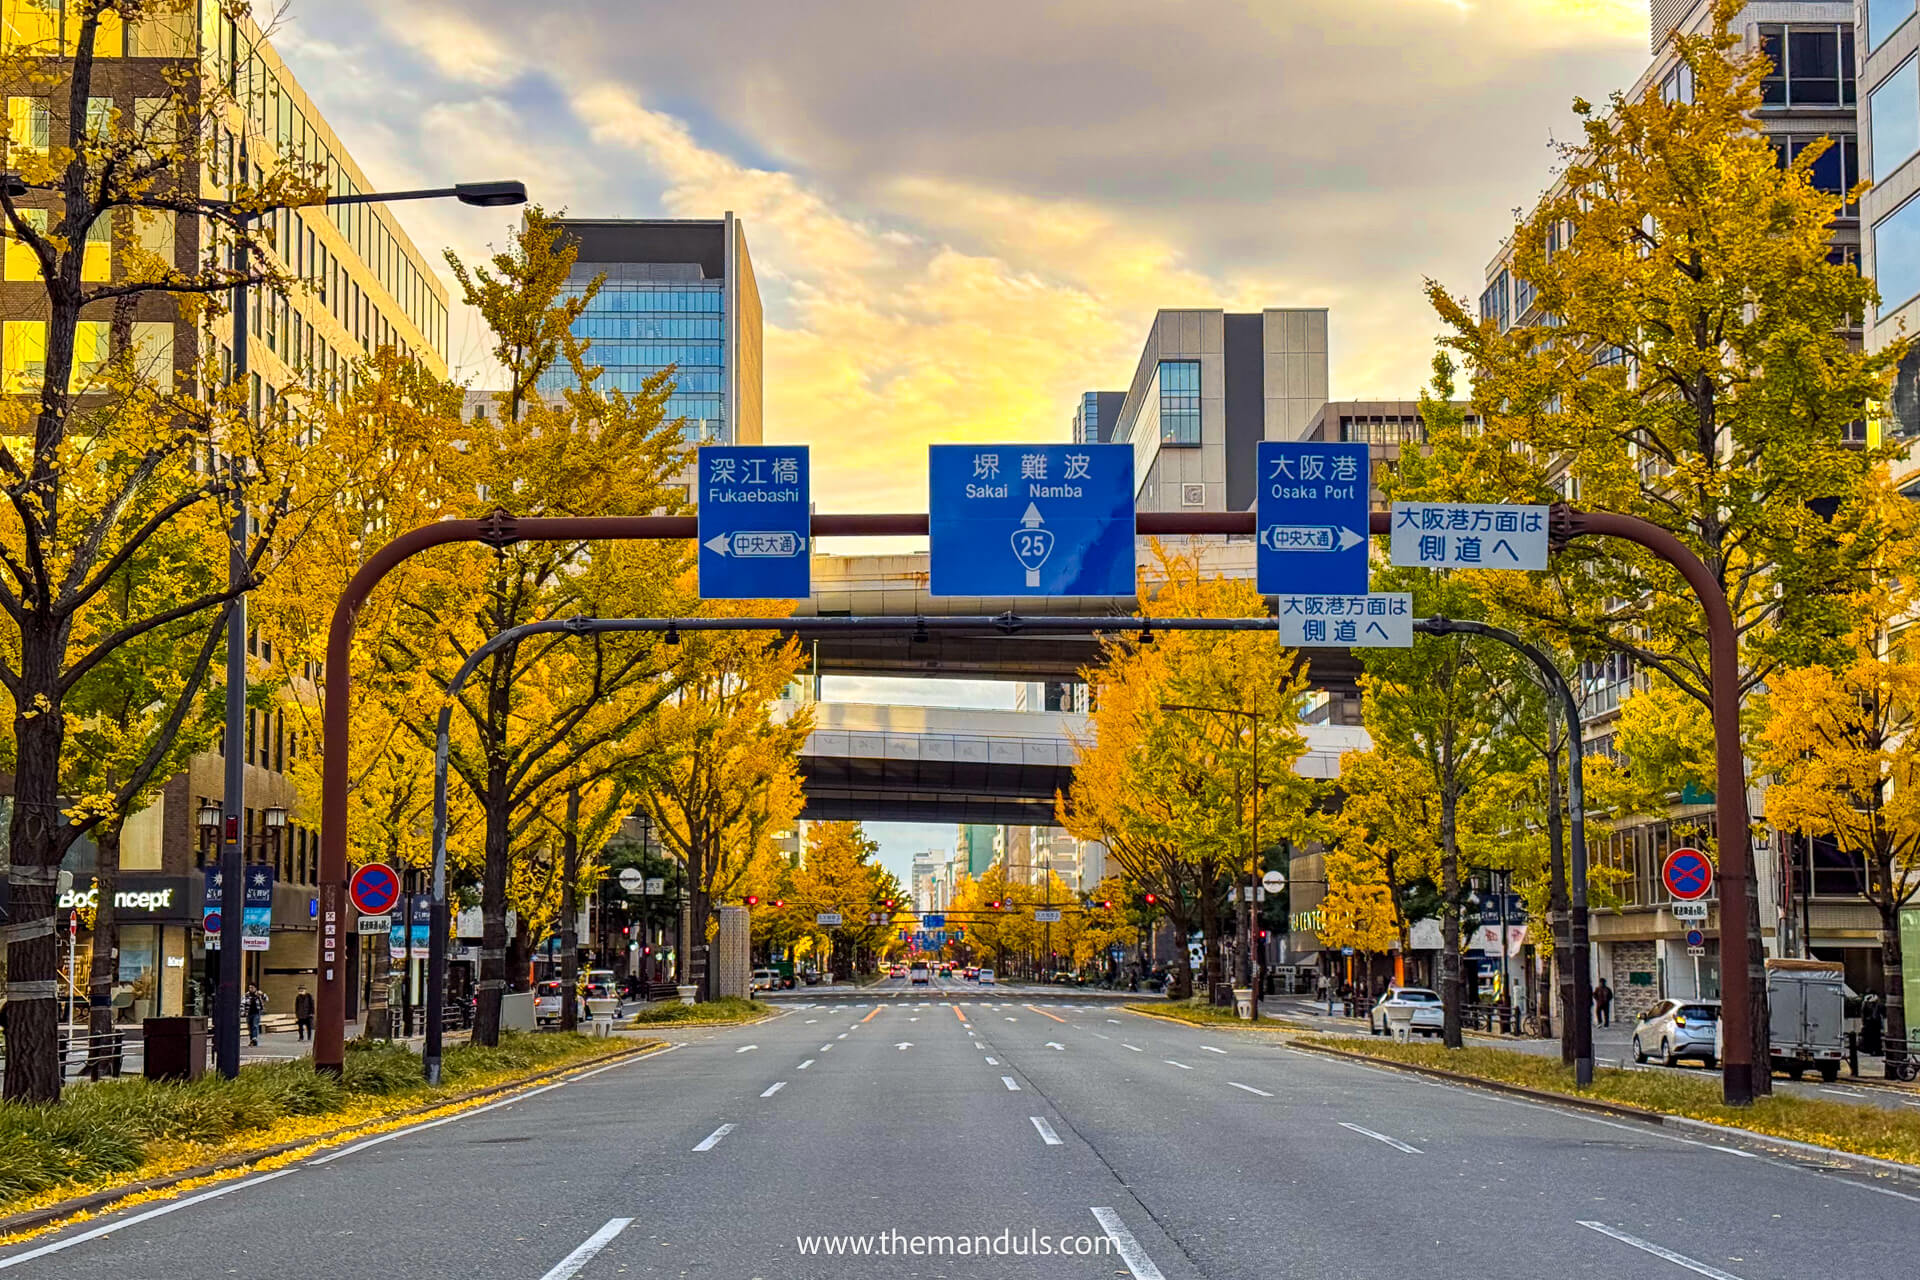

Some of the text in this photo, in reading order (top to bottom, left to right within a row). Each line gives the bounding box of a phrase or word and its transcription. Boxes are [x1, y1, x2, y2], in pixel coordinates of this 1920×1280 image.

[709, 457, 800, 485] 深江橋
[1269, 454, 1358, 482] 大阪港
[709, 487, 800, 503] Fukaebashi
[966, 483, 1083, 499] Sakai Namba
[1271, 484, 1355, 500] Osaka Port
[1397, 507, 1543, 533] 大阪港方面は
[736, 535, 794, 554] 中央大通
[1020, 535, 1045, 557] 25
[1276, 530, 1330, 548] 中央大通
[1418, 534, 1520, 563] 側道へ
[1283, 597, 1408, 616] 大阪港方面は
[1302, 619, 1389, 642] 側道へ
